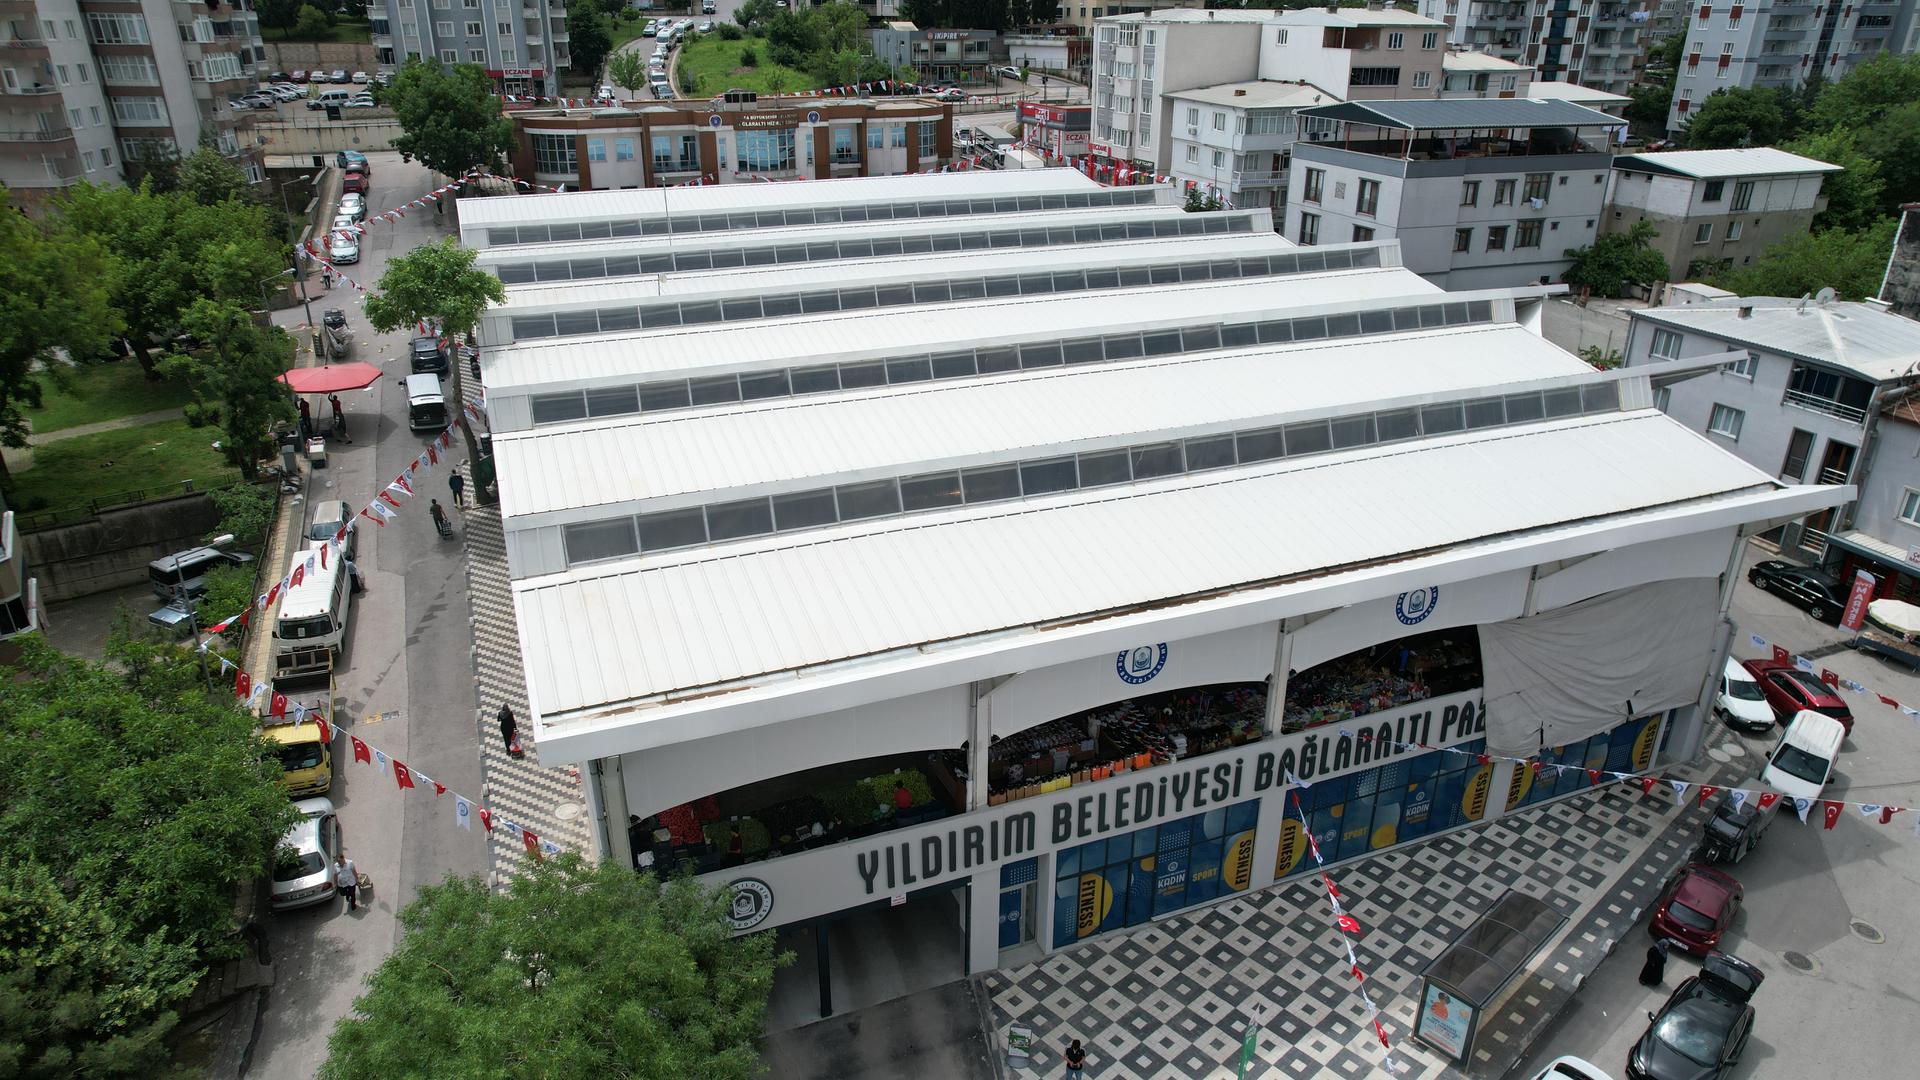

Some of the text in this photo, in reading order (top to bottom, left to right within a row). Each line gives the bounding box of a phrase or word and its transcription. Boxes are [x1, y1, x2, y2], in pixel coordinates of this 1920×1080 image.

[504, 68, 531, 76] ECZANE
[1637, 723, 1658, 766] FITNESS
[857, 811, 1036, 894] YILDIRIM
[1254, 710, 1432, 792] BAĞLARALTI
[1406, 803, 1430, 817] KADIN
[1470, 772, 1489, 815] FITNESS
[1235, 839, 1253, 885] FITNESS
[1280, 825, 1296, 871] FITNESS
[1157, 872, 1186, 889] KADIN
[1192, 868, 1218, 883] SPORT
[1080, 879, 1096, 929] FITNESS
